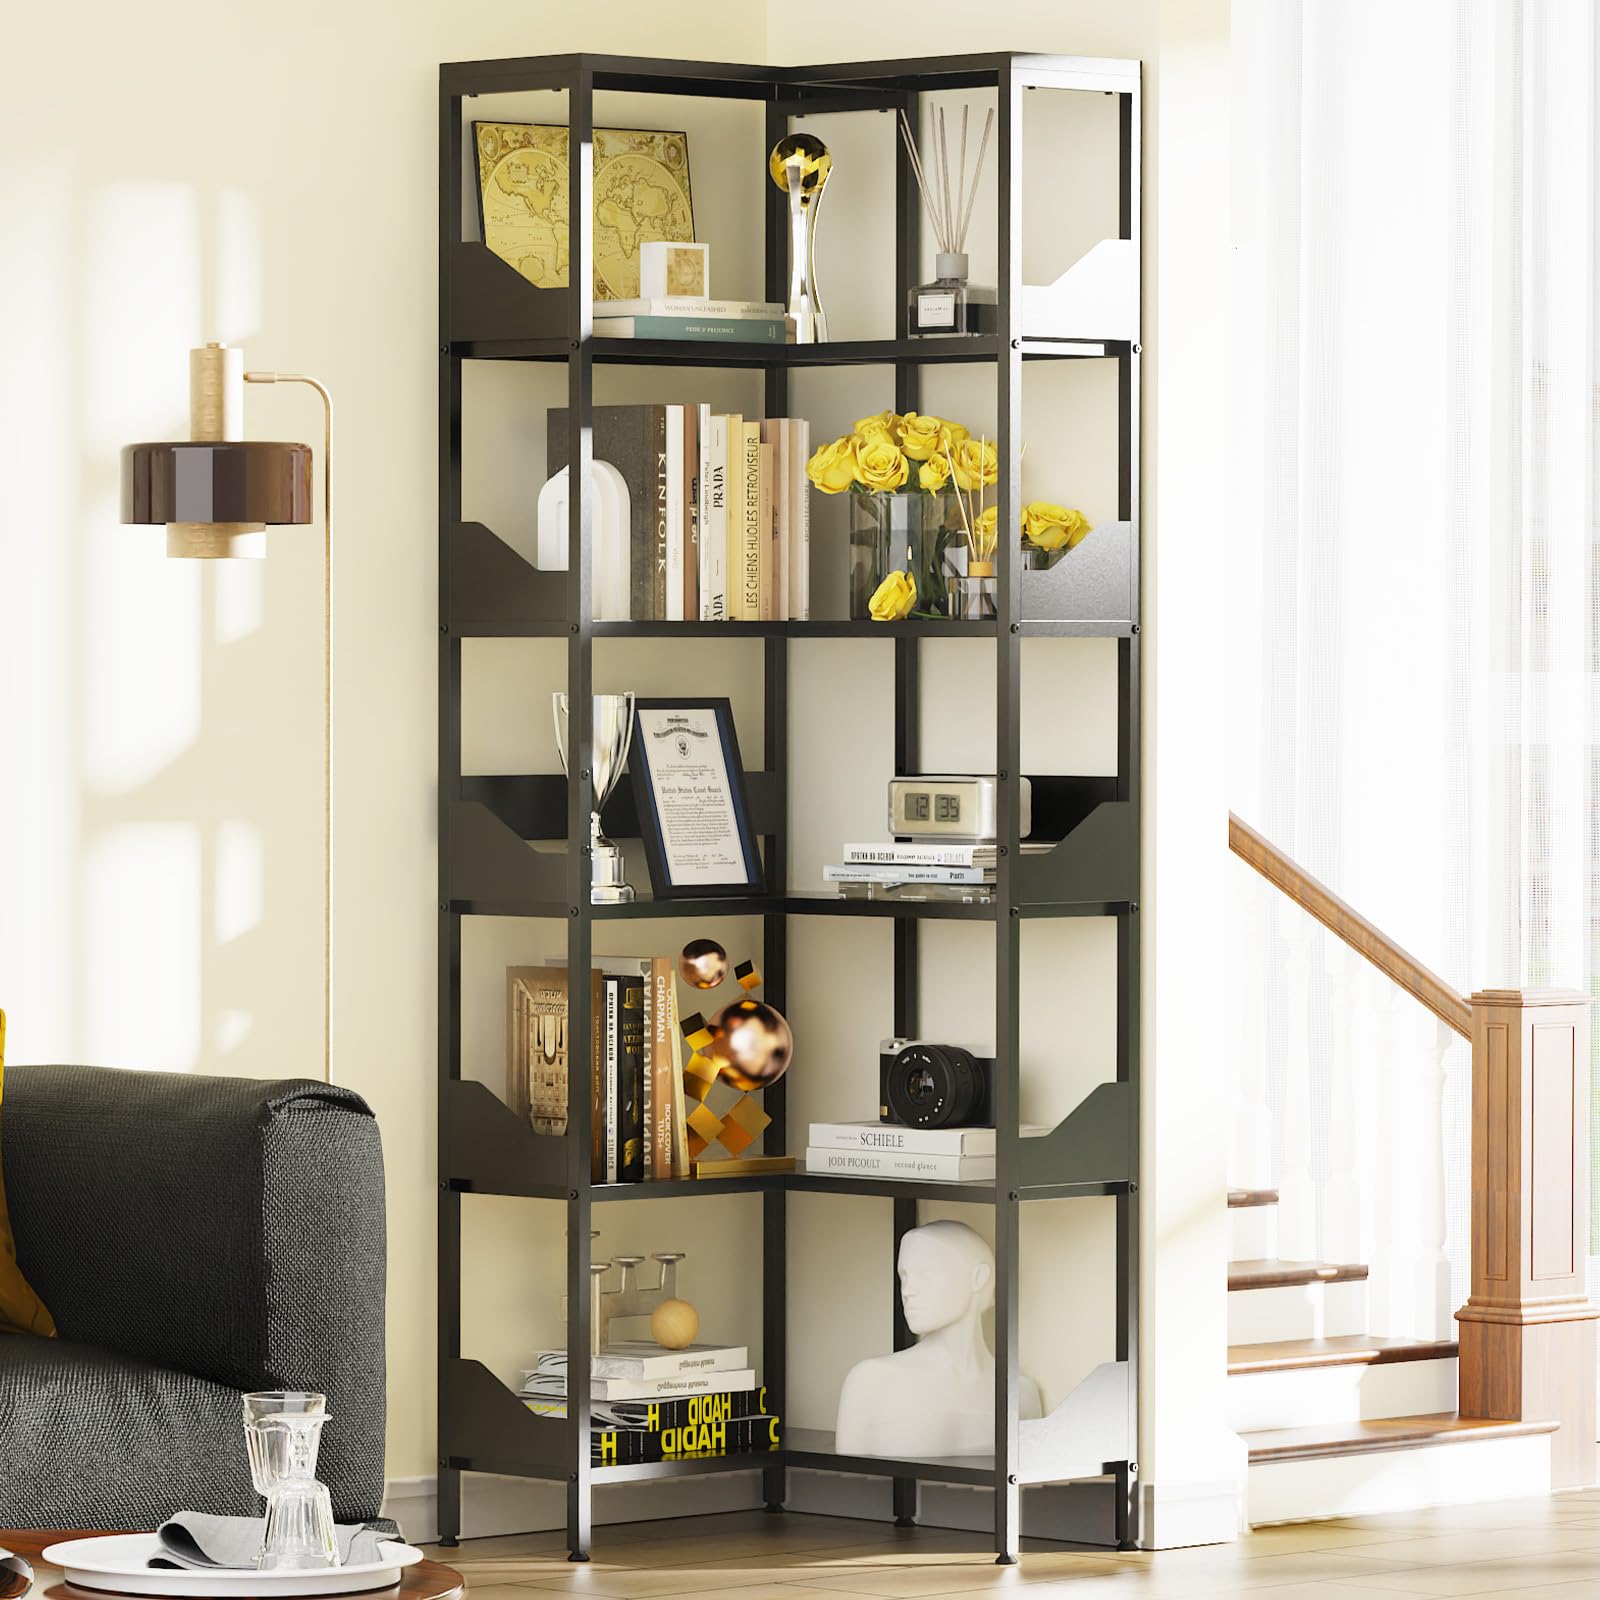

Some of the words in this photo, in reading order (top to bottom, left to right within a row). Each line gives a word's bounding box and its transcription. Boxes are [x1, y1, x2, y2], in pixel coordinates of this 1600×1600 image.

[713, 466, 724, 508] PRADA
[746, 437, 759, 507] RETROVISEUR
[658, 452, 667, 573] KINFOLK
[746, 509, 758, 551] HUOLES
[746, 552, 758, 590] CHIENS
[745, 591, 758, 609] LES
[915, 796, 929, 818] 12
[940, 796, 959, 819] 35
[657, 976, 666, 1043] CHAPMAN
[664, 1103, 672, 1132] BOOK
[664, 1132, 672, 1165] COVER
[860, 1132, 904, 1148] SCHIELE
[828, 1156, 846, 1169] JODI
[847, 1157, 881, 1169] PICOULT
[894, 1161, 916, 1170] second
[917, 1163, 937, 1172] glance
